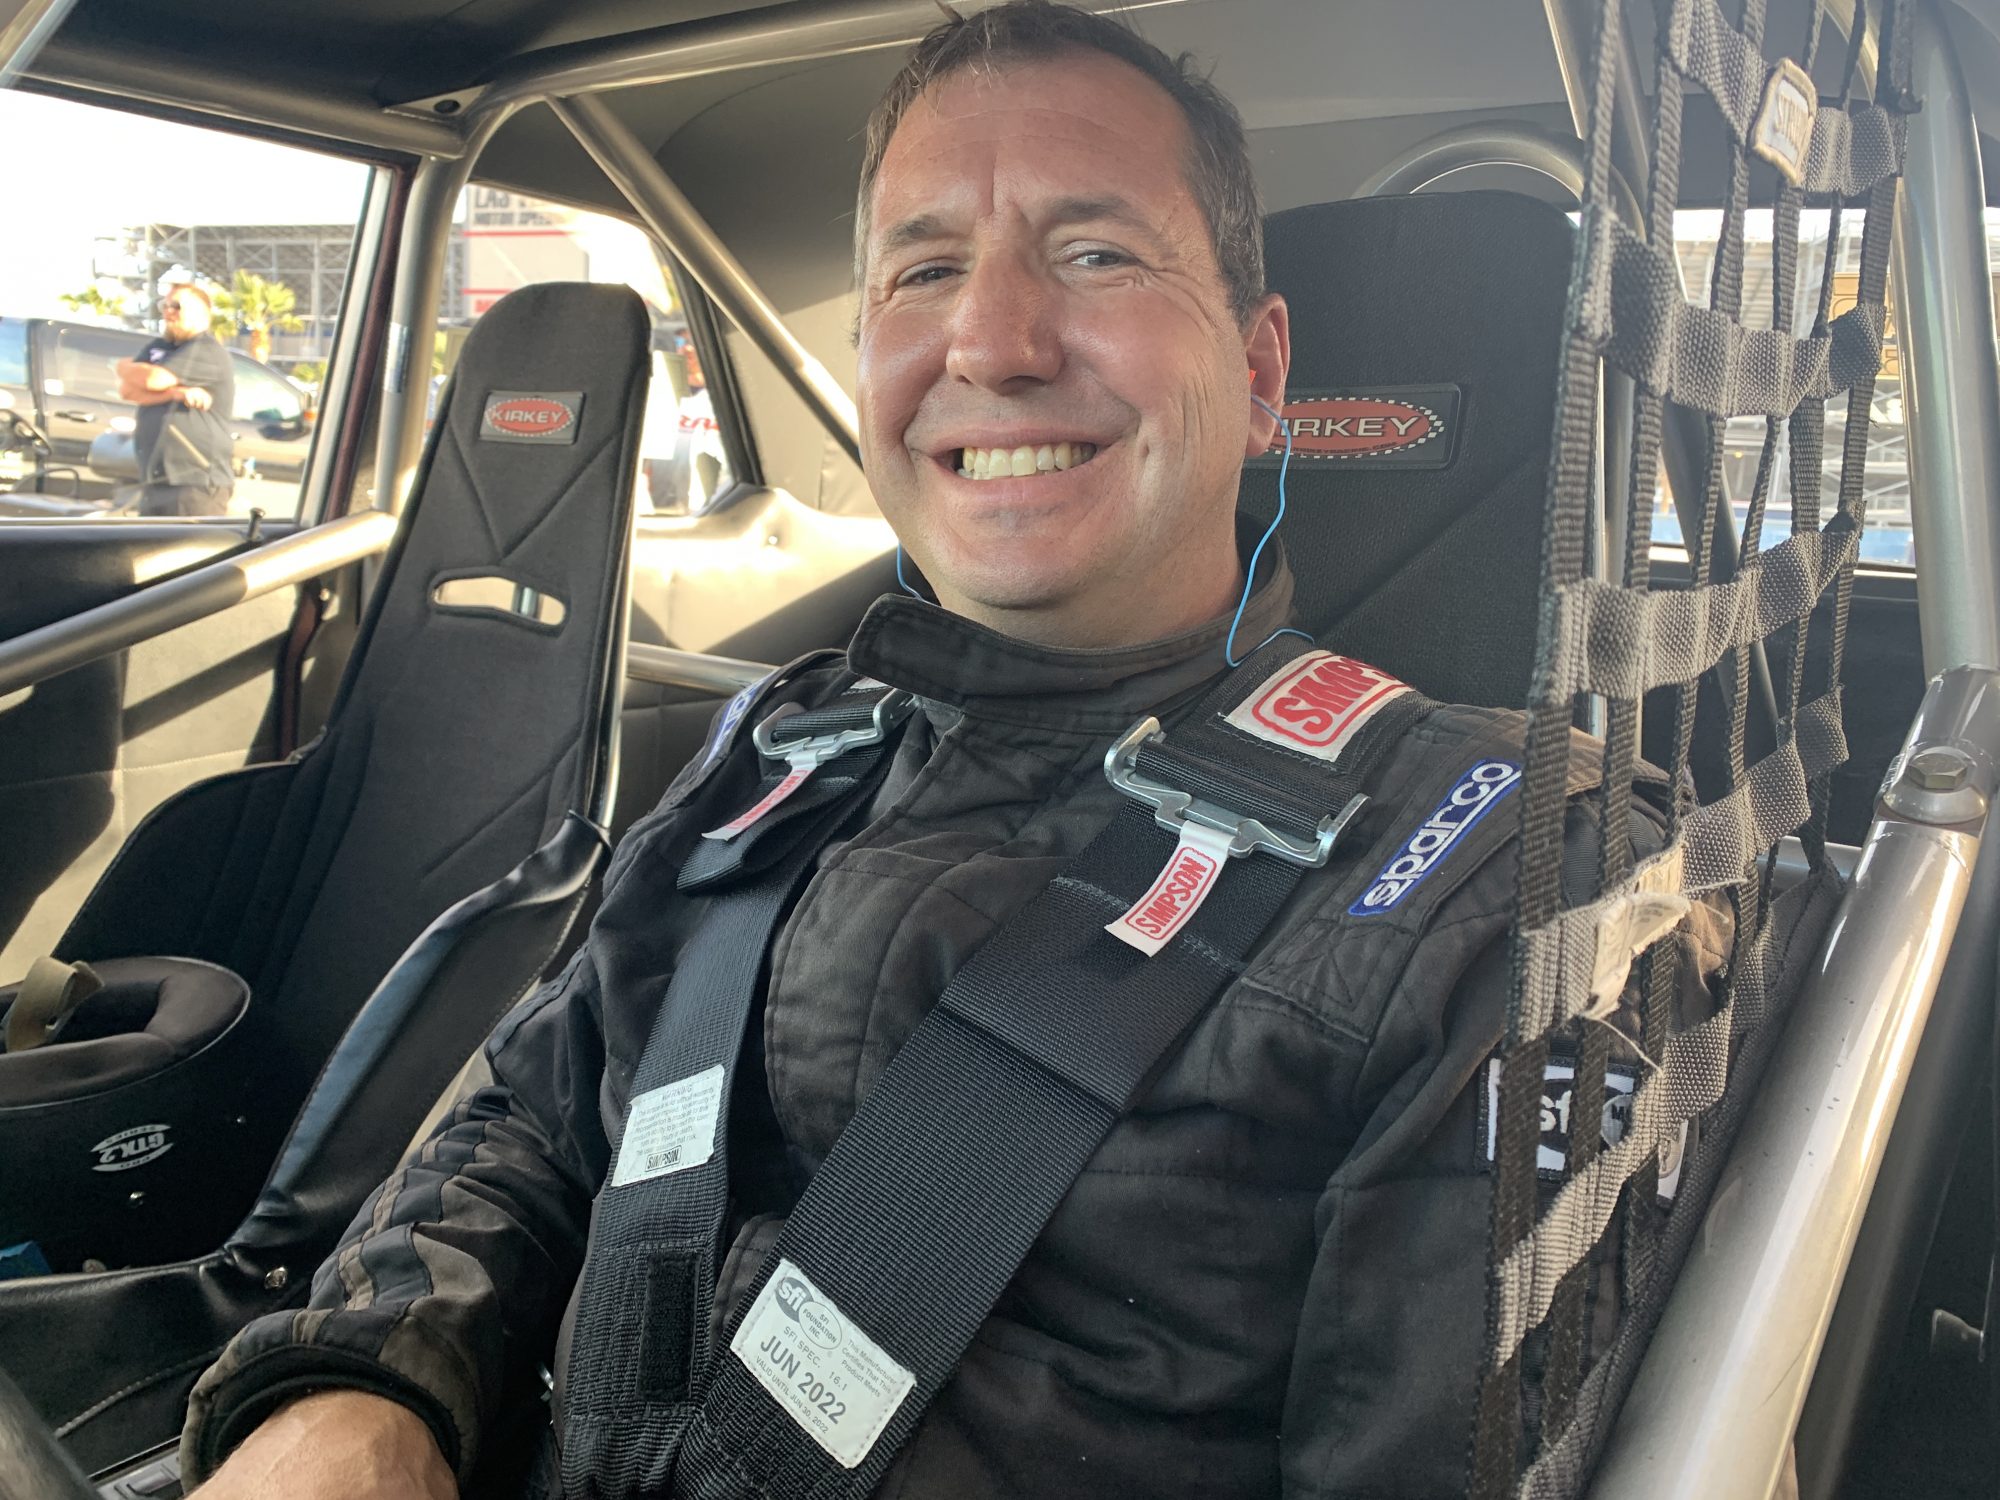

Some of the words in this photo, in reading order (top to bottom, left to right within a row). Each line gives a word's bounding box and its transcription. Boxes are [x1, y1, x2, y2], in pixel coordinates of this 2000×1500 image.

[493, 409, 563, 423] KIRKEY
[1279, 415, 1420, 438] IRKEY
[1363, 763, 1520, 907] sparco
[1135, 855, 1208, 934] SIMPSON
[647, 1149, 680, 1170] SIMPSON
[778, 1282, 807, 1312] sfi
[802, 1308, 838, 1344] FOUNDATION
[819, 1313, 830, 1326] SFI
[783, 1326, 798, 1342] SFI
[797, 1340, 821, 1369] SPEC.
[829, 1371, 848, 1391] 16.1
[841, 1359, 865, 1383] Product
[760, 1335, 801, 1380] JUN
[797, 1371, 847, 1425] 2022
[866, 1367, 880, 1383] That
[756, 1356, 774, 1377] VALID
[771, 1374, 790, 1396] UNTIL
[789, 1392, 803, 1409] JUN
[802, 1406, 812, 1420] 30,
[812, 1416, 829, 1434] 2022
